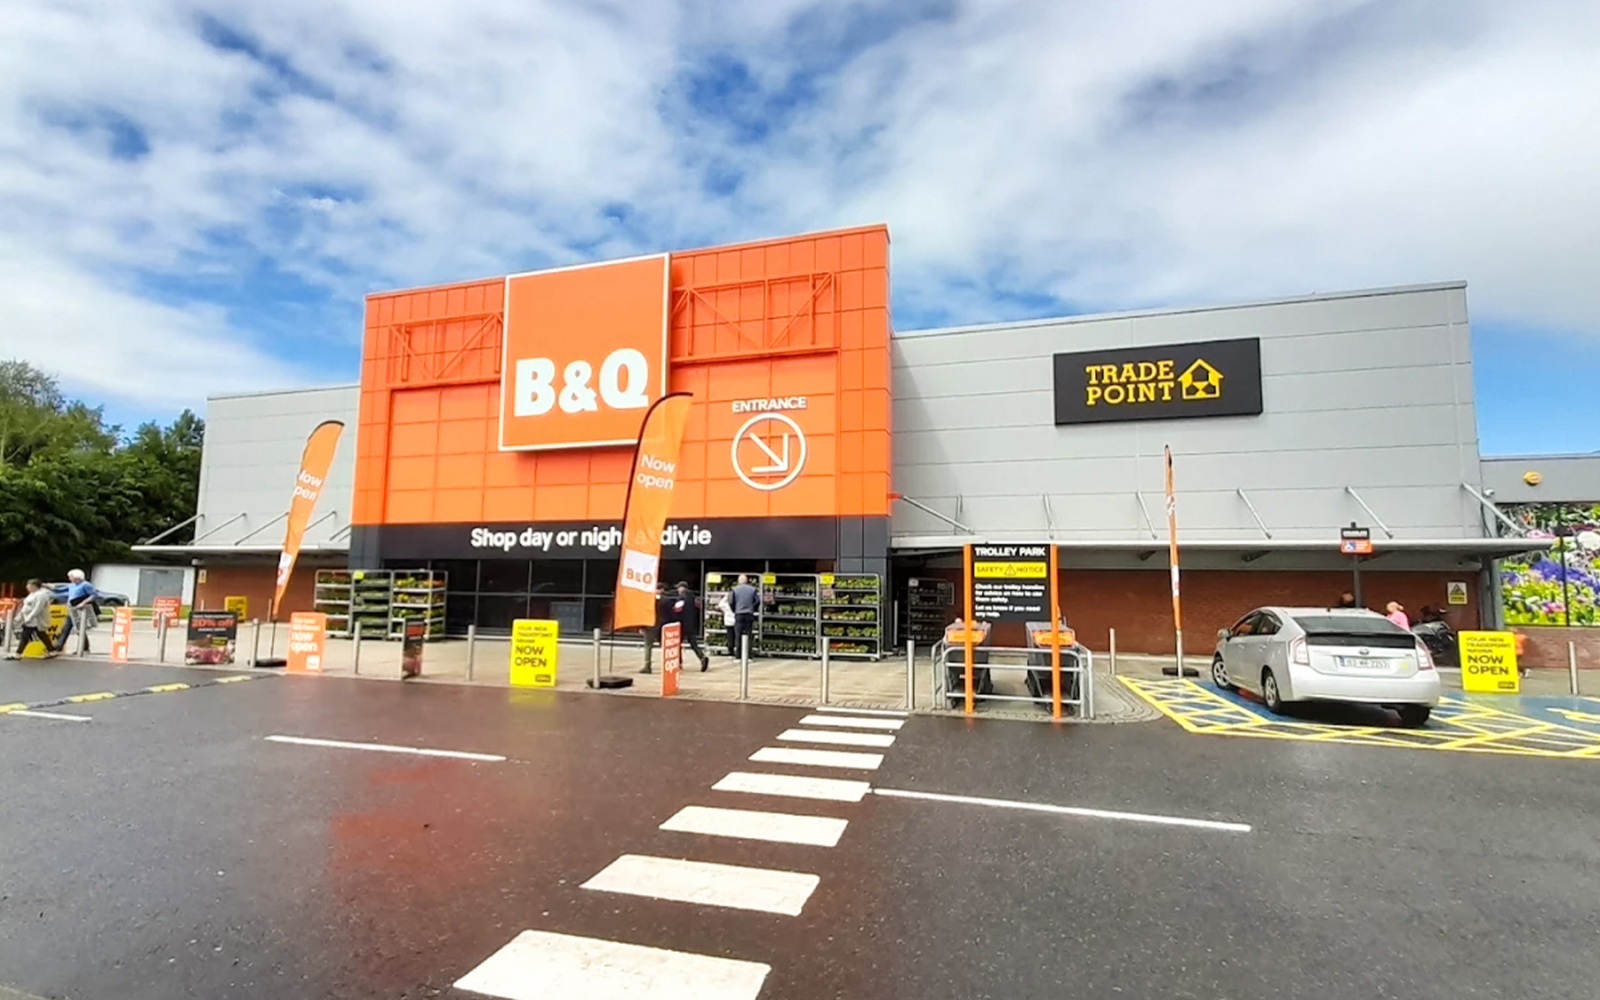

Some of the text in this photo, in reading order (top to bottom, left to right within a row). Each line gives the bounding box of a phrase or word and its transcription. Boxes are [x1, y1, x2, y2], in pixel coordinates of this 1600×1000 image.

[1086, 360, 1174, 385] TRADE
[513, 348, 649, 417] B&Q
[1086, 381, 1175, 405] POINT
[732, 397, 807, 413] ENTRANCE
[641, 454, 676, 474] Now
[636, 474, 674, 490] open
[470, 528, 517, 551] Shop
[519, 527, 553, 551] day
[556, 530, 577, 546] or
[581, 526, 622, 551] nigh
[974, 547, 1046, 557] TROLLEY PARK
[626, 568, 653, 584] B&Q
[516, 646, 544, 656] NOW
[515, 657, 547, 668] OPEN
[1467, 655, 1504, 664] NOW
[1468, 665, 1509, 675] OPEN
